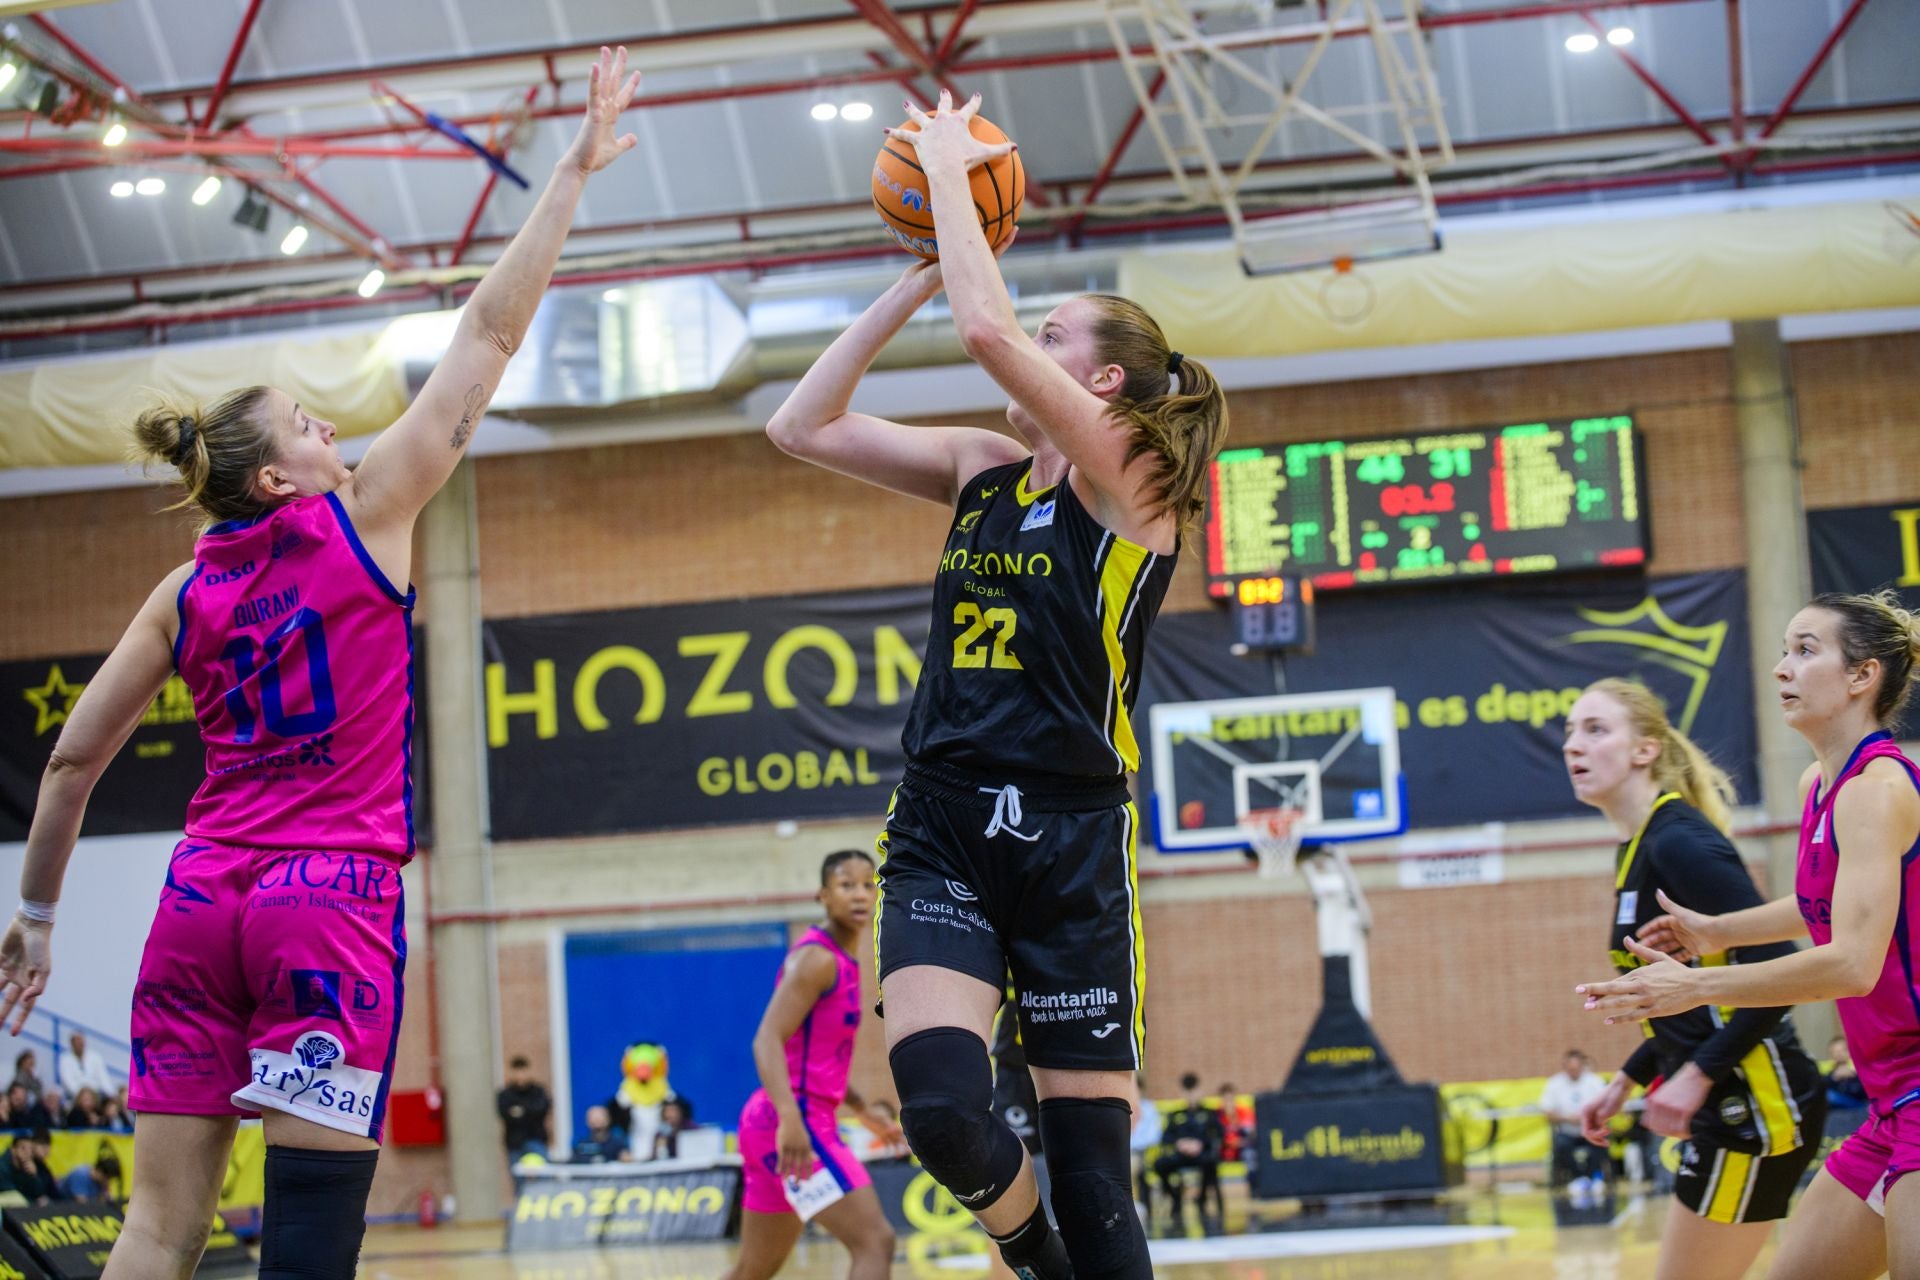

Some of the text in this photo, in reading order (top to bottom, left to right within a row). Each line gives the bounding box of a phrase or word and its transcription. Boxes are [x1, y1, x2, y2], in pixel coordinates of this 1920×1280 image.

[940, 549, 1052, 577] HOZONO
[964, 582, 1006, 597] GLOBAL
[952, 602, 1024, 670] 22
[218, 606, 337, 743] 10
[1417, 694, 1469, 729] es
[698, 748, 879, 796] GLOBAL
[257, 851, 387, 904] CICAR
[251, 892, 382, 923] Canary Islands Car
[911, 899, 954, 916] Costa
[911, 913, 937, 922] Región
[1020, 987, 1118, 1008] Alcantarilla
[1048, 1010, 1057, 1022] la
[1057, 1007, 1085, 1022] huerta
[1086, 1006, 1107, 1019] nace
[515, 1185, 725, 1224] HOZONO
